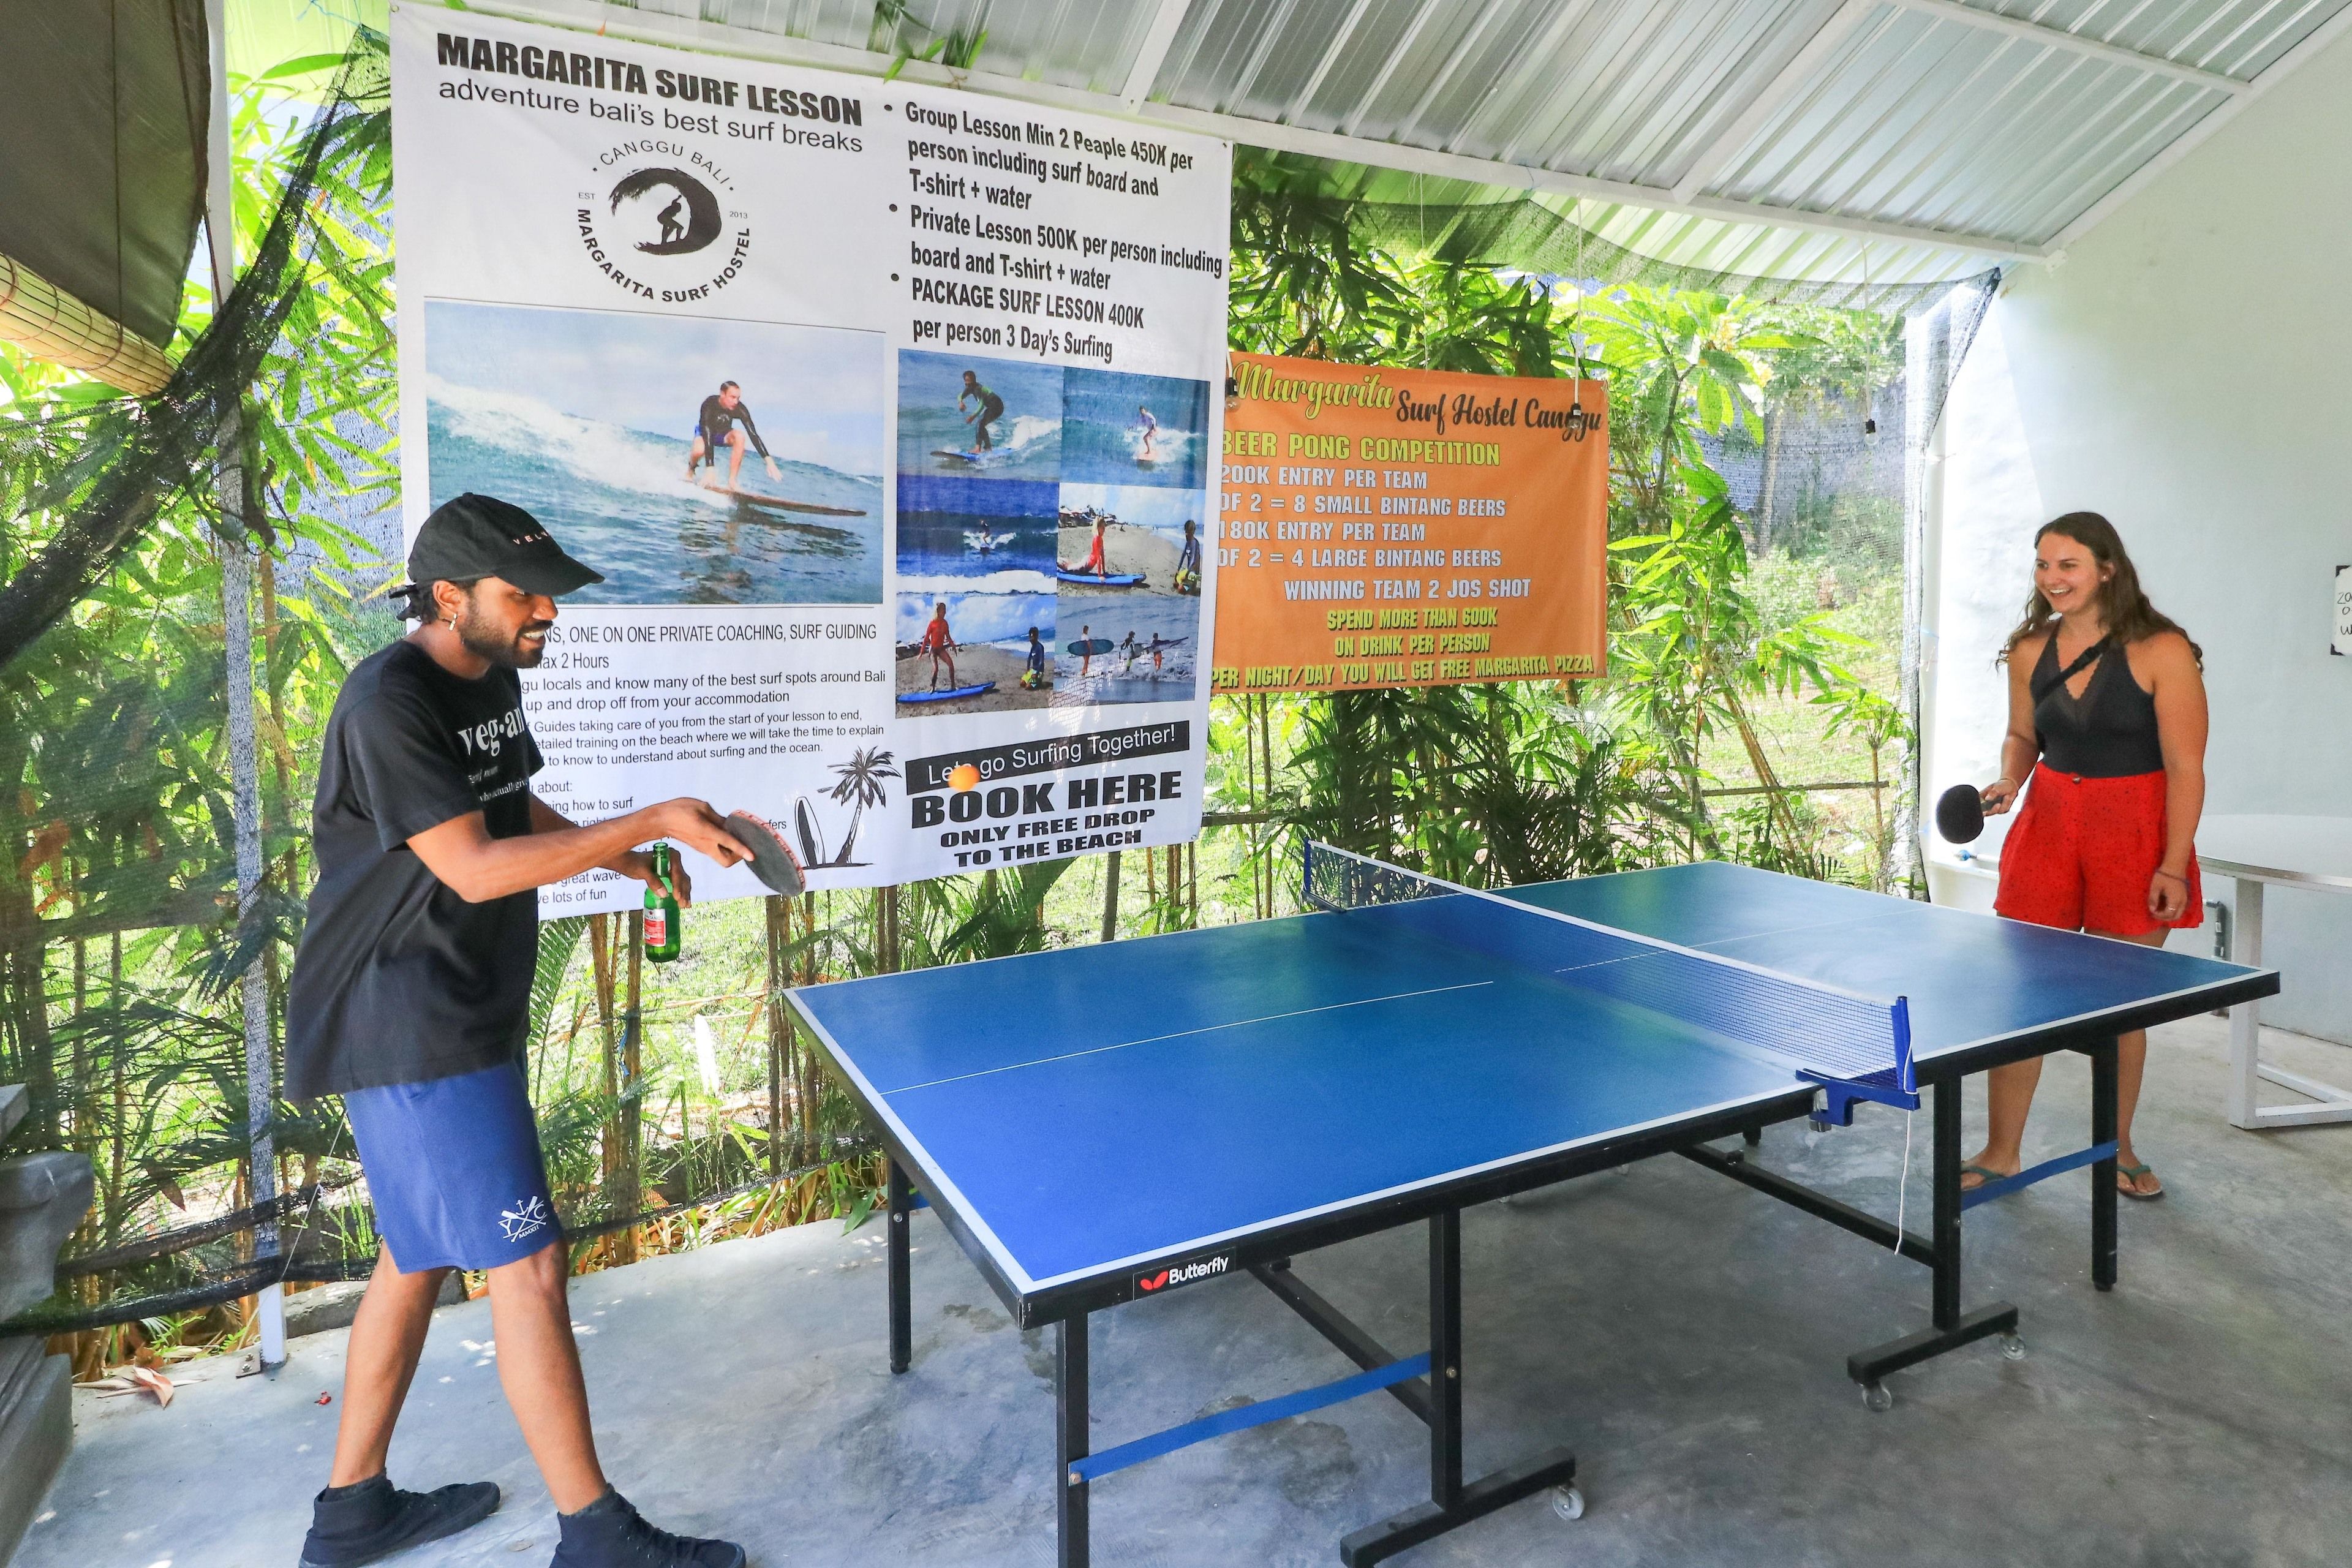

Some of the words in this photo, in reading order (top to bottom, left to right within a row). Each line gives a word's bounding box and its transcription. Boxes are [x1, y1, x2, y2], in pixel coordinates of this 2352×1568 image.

[437, 33, 647, 98] MARGARITA
[655, 70, 738, 107] SURF
[747, 85, 862, 126] LESSON
[440, 78, 579, 113] adventure
[665, 108, 718, 134] best
[728, 122, 775, 141] surf
[783, 124, 862, 152] breaks
[906, 102, 957, 134] Group
[963, 111, 1020, 141] Lesson
[1027, 123, 1054, 146] Min
[1060, 128, 1069, 148] 2
[1074, 131, 1126, 160] Peaple
[1131, 141, 1166, 166] 450K
[1170, 153, 1193, 173] per
[600, 140, 683, 165] CANGGU
[691, 152, 729, 184] BALI
[908, 140, 967, 163] person
[972, 146, 1046, 183] including
[1052, 162, 1082, 183] surf
[1087, 164, 1127, 192] board
[1132, 177, 1158, 196] and
[910, 168, 965, 198] T-shirt
[986, 186, 1031, 209] water
[578, 209, 654, 299] MARGARITA
[662, 284, 709, 302] SURF
[713, 228, 749, 288] HOSTEL
[911, 205, 970, 235] Private
[976, 215, 1031, 245] Lesson
[1038, 225, 1078, 251] 500K
[1083, 237, 1107, 257] per
[1110, 241, 1156, 263] person
[1161, 244, 1222, 279] including
[912, 241, 959, 270] board
[966, 252, 994, 274] and
[1000, 254, 1051, 281] T-shirt
[1071, 268, 1110, 289] water
[913, 277, 993, 309] PACKAGE
[1000, 288, 1041, 314] SURF
[1047, 295, 1104, 323] LESSON
[1109, 304, 1144, 328] 400K
[913, 320, 941, 342] per
[947, 323, 1000, 345] person
[1007, 325, 1015, 347] 3
[1064, 332, 1112, 364] Surfing
[1232, 360, 1395, 420] Margarita
[1396, 390, 1447, 435] Surf
[1453, 394, 1517, 428] Hostel
[1223, 431, 1278, 457] BEER
[1289, 434, 1349, 460] PONG
[1360, 437, 1500, 466] COMPETITION
[1221, 464, 1270, 485] 200K
[1278, 467, 1335, 488] ENTRY
[1344, 469, 1376, 488] PER
[1383, 471, 1428, 489] TEAM
[1220, 492, 1242, 511] OF
[1250, 493, 1262, 513] 2
[1294, 495, 1306, 513] 8
[1314, 496, 1373, 515] SMALL
[1380, 496, 1451, 517] BINTANG
[1458, 497, 1507, 518] BEERS
[1219, 521, 1270, 541] 180K
[1277, 521, 1333, 541] ENTRY
[1343, 522, 1375, 541] PER
[1382, 523, 1426, 542] TEAM
[1218, 548, 1240, 567] OF
[1248, 548, 1262, 567] 2
[1291, 549, 1304, 568] 4
[1312, 549, 1367, 568] LARGE
[1374, 549, 1446, 568] BINTANG
[1452, 549, 1502, 567] BEERS
[1284, 579, 1365, 601] WINNING
[1373, 579, 1421, 600] TEAM
[1428, 579, 1440, 599] 2
[1447, 579, 1481, 598] JOS
[1488, 578, 1531, 598] SHOT
[570, 627, 598, 642] ONE
[603, 627, 622, 642] ON
[628, 627, 655, 642] ONE
[661, 626, 713, 641] PRIVATE
[717, 624, 786, 643] COACHING,
[790, 625, 822, 639] SURF
[826, 624, 876, 639] GUIDING
[1327, 608, 1374, 630] SPEND
[1379, 608, 1418, 629] MORE
[1423, 608, 1457, 628] THAN
[562, 653, 568, 668] 2
[574, 653, 609, 668] Hours
[1335, 636, 1355, 657] ON
[1359, 635, 1403, 656] DRINK
[1409, 634, 1435, 654] PER
[1439, 633, 1490, 654] PERSON
[544, 678, 581, 690] locals
[587, 677, 610, 689] and
[616, 677, 649, 688] know
[654, 679, 688, 690] many
[693, 675, 704, 686] of
[708, 675, 726, 686] the
[731, 674, 756, 685] best
[760, 672, 782, 684] surf
[786, 672, 816, 685] spots
[821, 671, 860, 682] around
[865, 671, 885, 681] Bali
[1212, 667, 1239, 688] PER
[1340, 662, 1370, 684] YOU
[1374, 661, 1407, 683] WILL
[1411, 660, 1436, 680] GET
[1440, 658, 1471, 679] FREE
[1474, 655, 1550, 679] MARGARITA
[1554, 654, 1594, 675] PIZZA
[526, 702, 542, 713] up
[548, 698, 571, 710] and
[577, 698, 605, 712] drop
[611, 696, 627, 709] off
[631, 696, 658, 708] from
[664, 697, 691, 710] your
[695, 691, 789, 705] accommodation
[549, 756, 559, 766] to
[564, 755, 593, 764] know
[597, 755, 607, 764] to
[612, 750, 673, 764] understand
[677, 749, 706, 760] about
[710, 747, 744, 758] surfing
[748, 745, 766, 755] and
[771, 744, 786, 753] the
[789, 742, 823, 753] ocean.
[980, 757, 1005, 779] go
[1013, 736, 1082, 767] Surfing
[1087, 725, 1175, 756] Together!
[538, 781, 572, 794] about:
[912, 783, 1055, 829] BOOK
[1068, 771, 1181, 809] HERE
[941, 826, 1011, 847] ONLY
[1018, 817, 1077, 838] FREE
[1085, 809, 1155, 829] DROP
[954, 850, 991, 867] TO
[999, 842, 1050, 861] THE
[1057, 830, 1141, 853] BEACH
[1169, 1256, 1229, 1284] Butterfly
